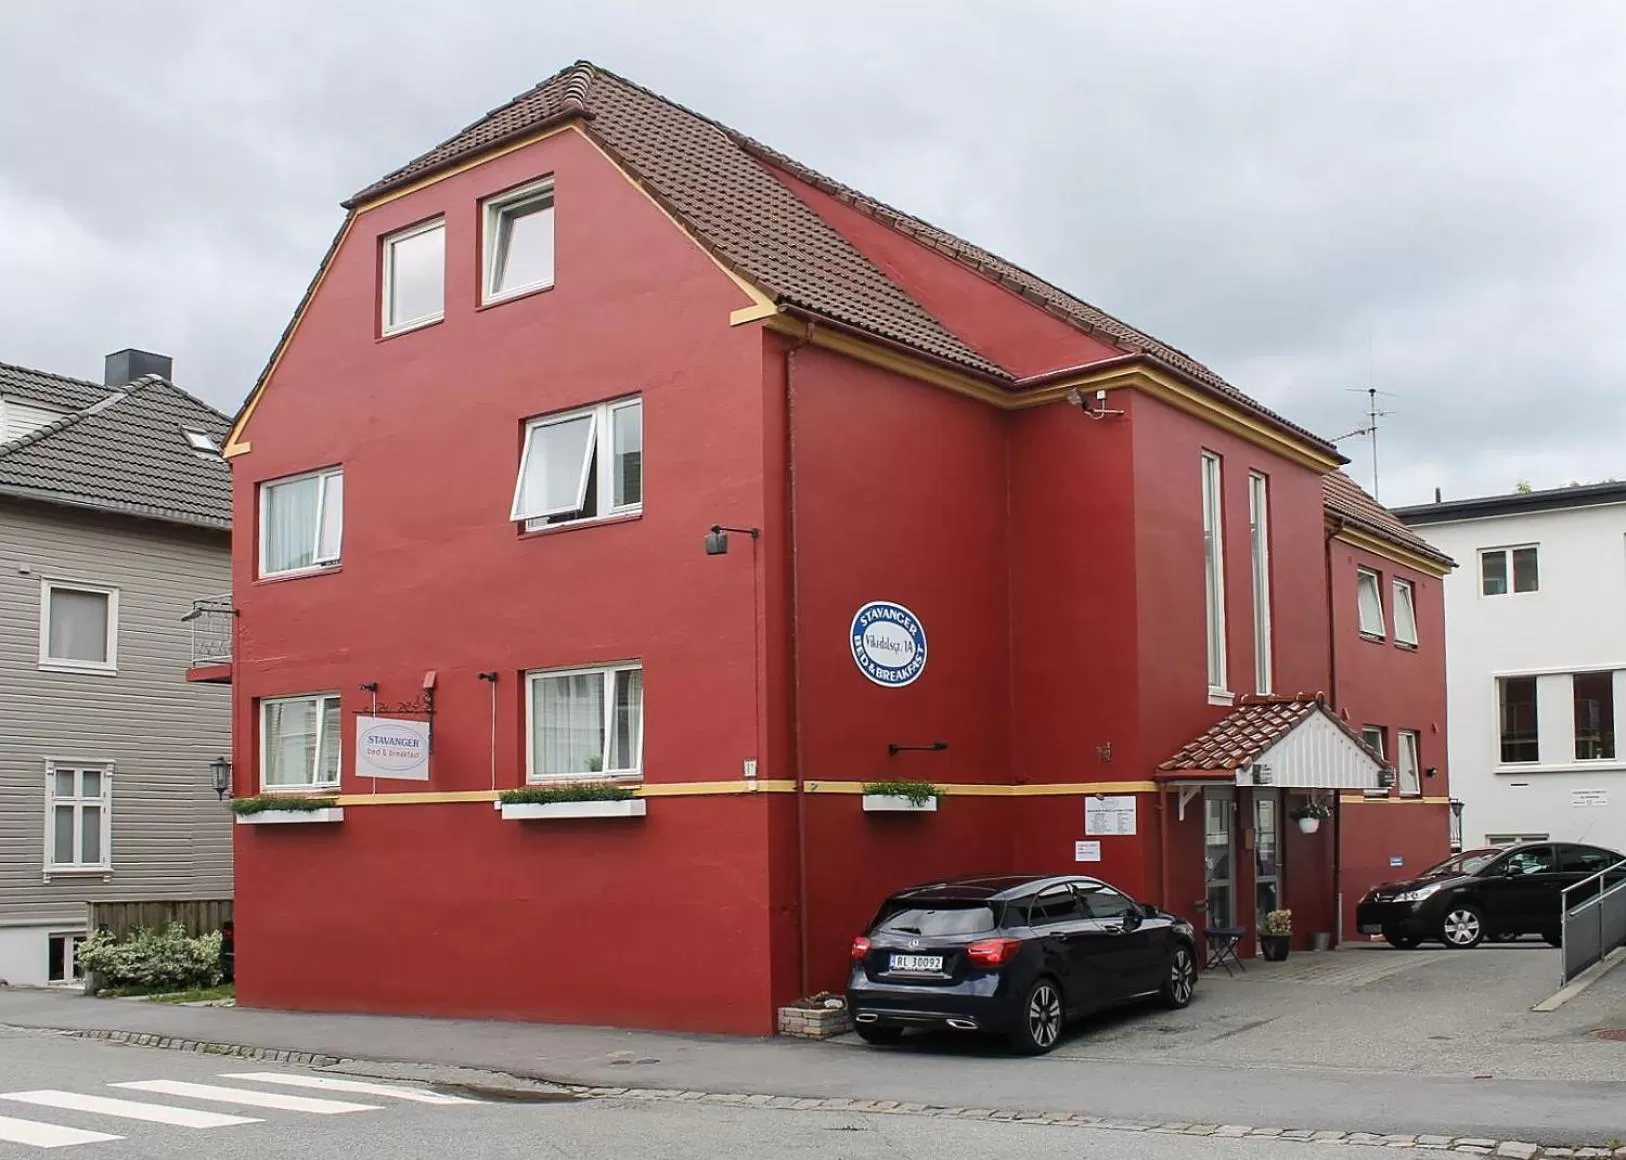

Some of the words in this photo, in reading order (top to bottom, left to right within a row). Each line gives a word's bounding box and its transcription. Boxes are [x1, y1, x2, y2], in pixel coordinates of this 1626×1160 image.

[860, 607, 917, 636] STAVANGER
[854, 635, 869, 667] BED
[868, 664, 876, 675] &
[875, 643, 924, 682] BREAKFAST
[368, 735, 419, 748] STAVANGER
[367, 747, 381, 756] bed
[382, 748, 387, 757] &
[389, 748, 420, 759] breakfast
[897, 957, 908, 967] RL
[912, 957, 941, 968] 30092
